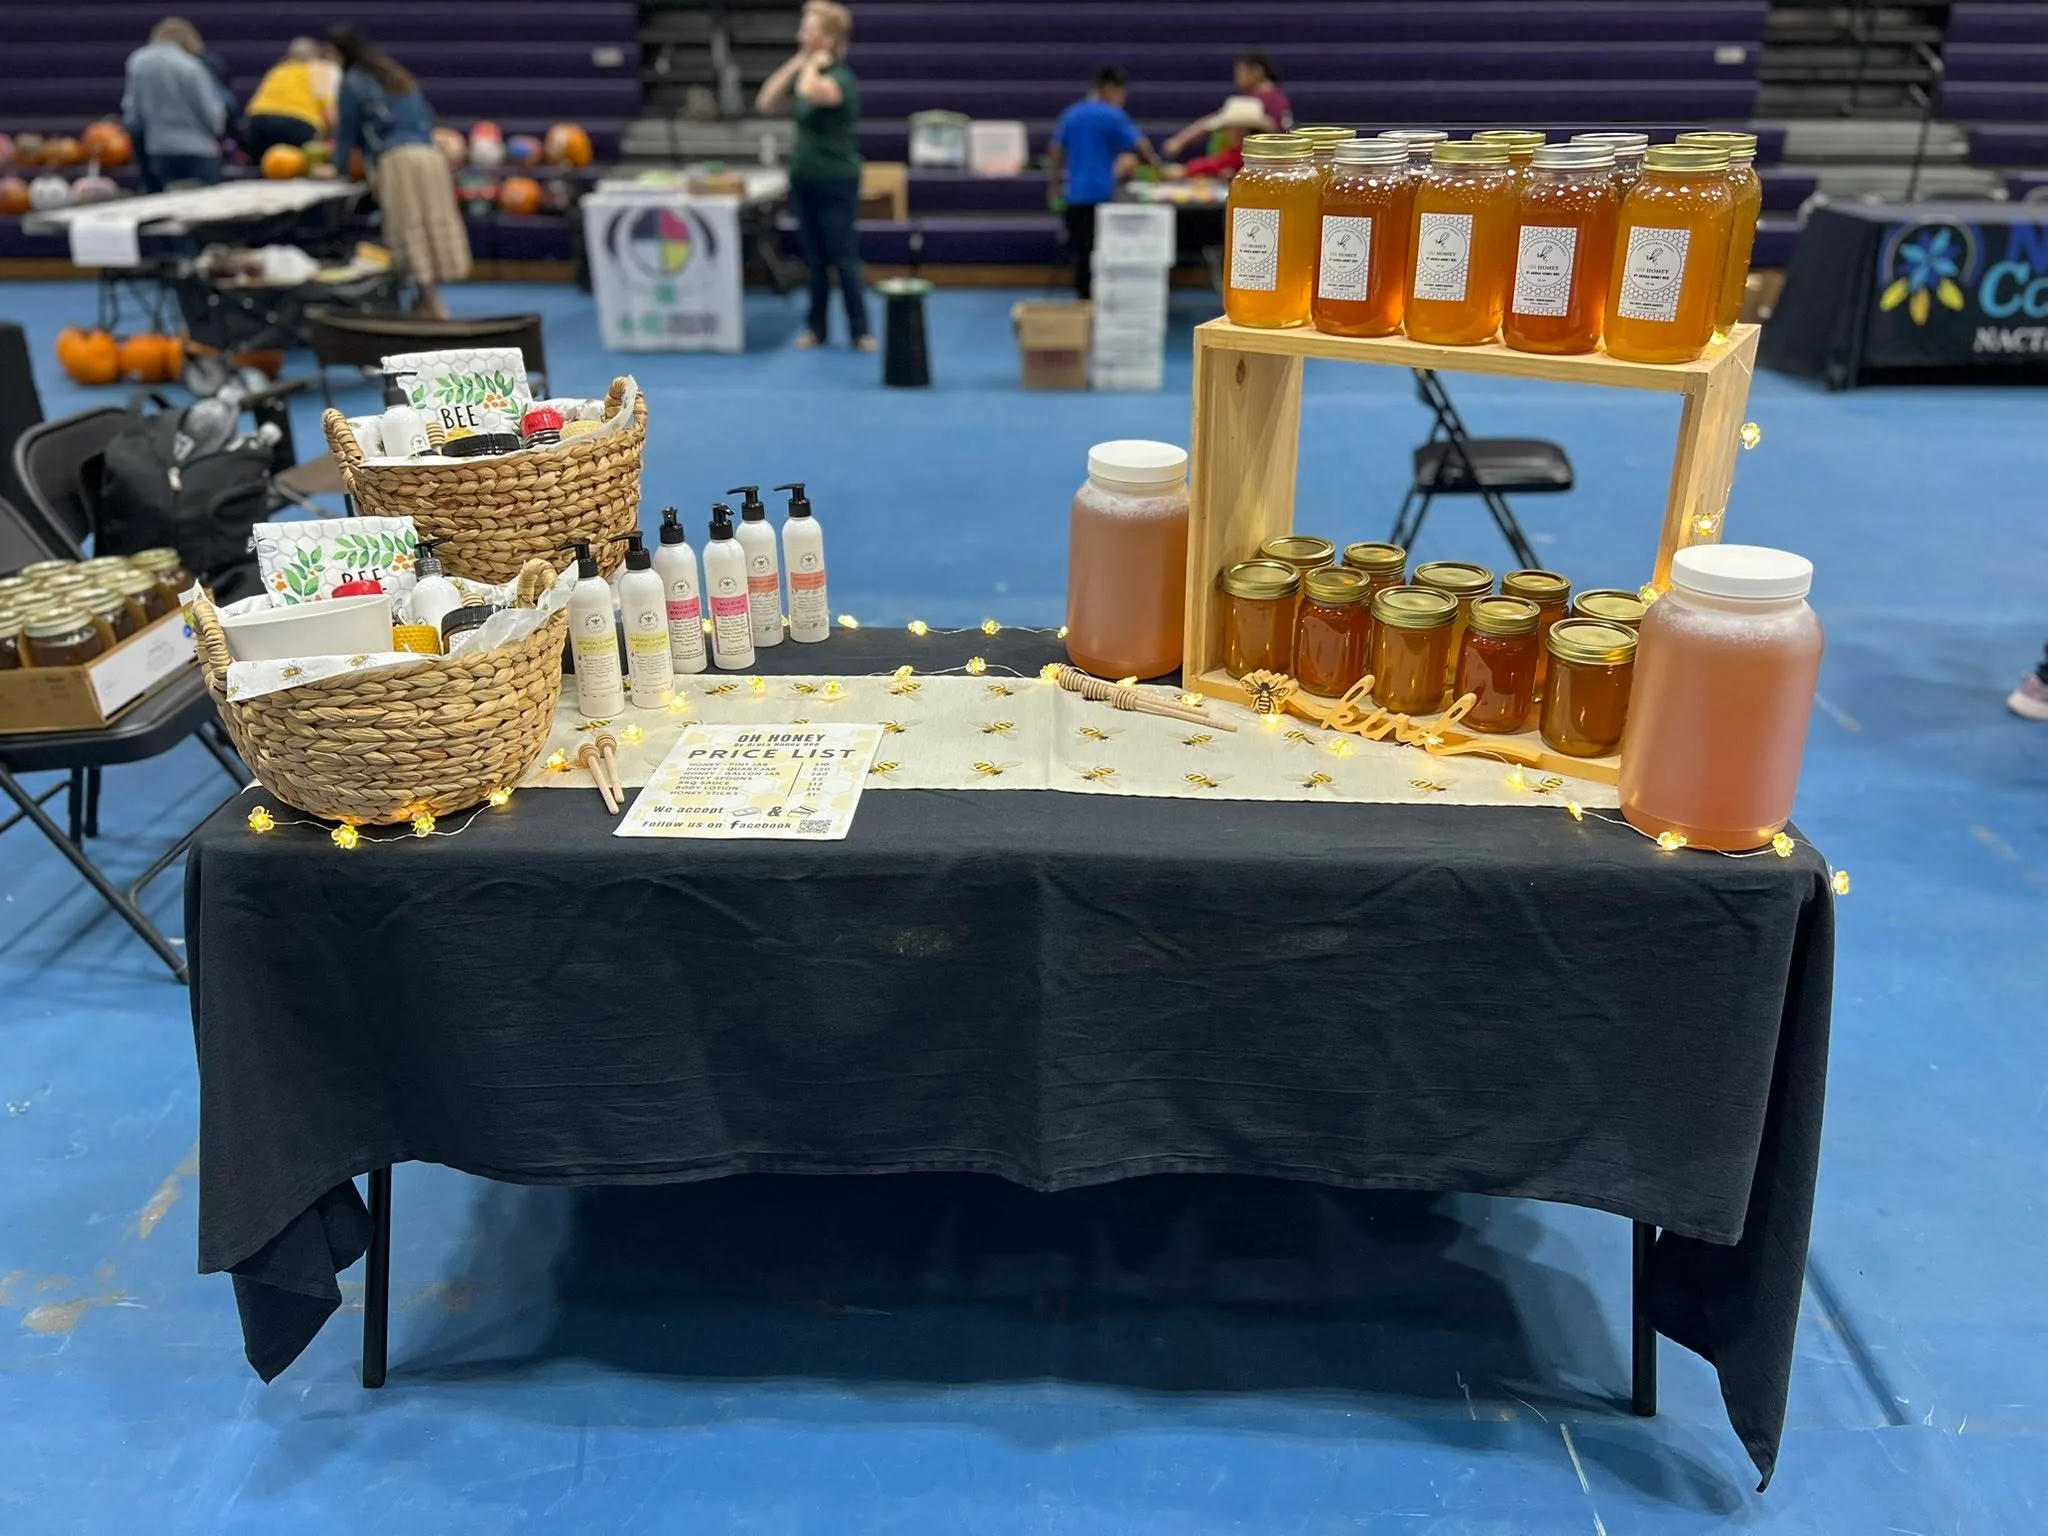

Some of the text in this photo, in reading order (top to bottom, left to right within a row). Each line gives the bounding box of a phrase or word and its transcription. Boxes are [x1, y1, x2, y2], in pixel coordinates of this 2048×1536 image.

[440, 404, 479, 429] BEE
[1320, 674, 1478, 755] kind
[737, 734, 826, 743] OH HONEY
[688, 749, 857, 759] PRICE LIST
[677, 806, 724, 814] accept
[768, 806, 782, 817] &
[642, 820, 684, 828] Follow
[730, 820, 792, 830] facebook
